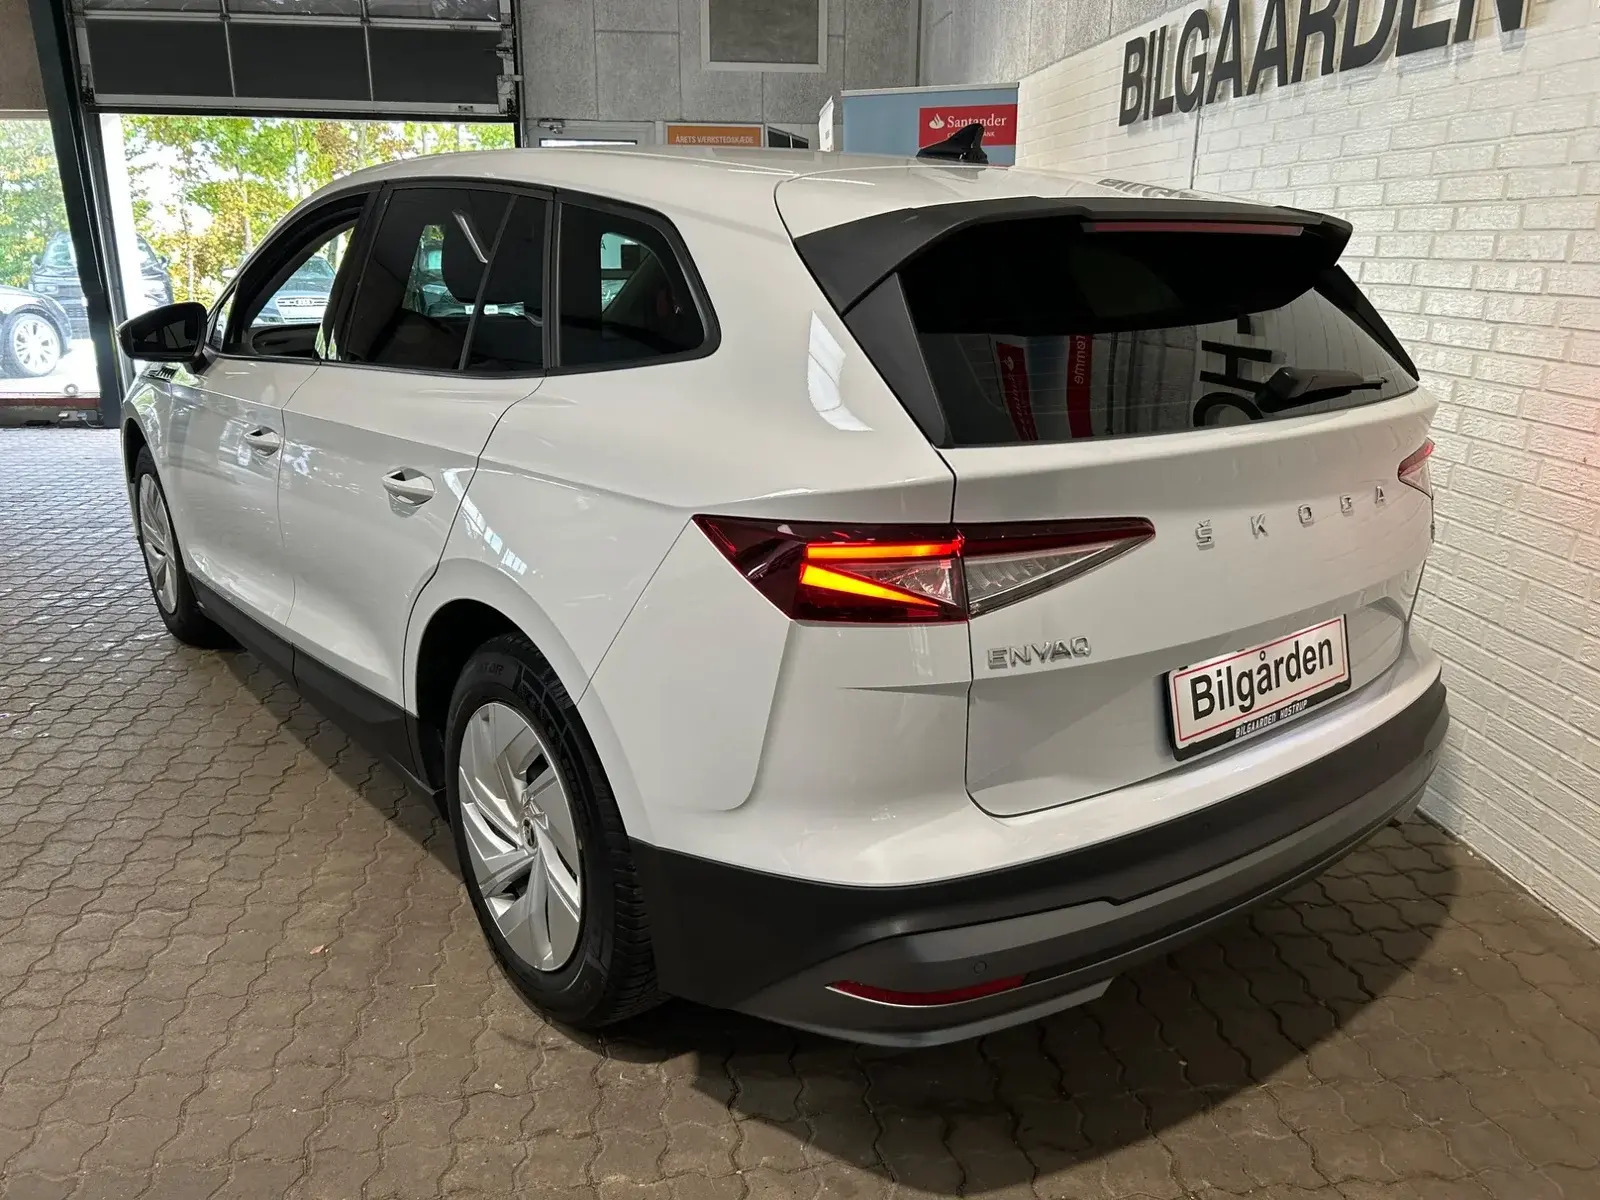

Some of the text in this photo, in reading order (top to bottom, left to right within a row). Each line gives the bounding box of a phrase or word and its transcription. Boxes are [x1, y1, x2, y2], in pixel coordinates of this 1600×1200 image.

[1118, 0, 1523, 127] BILGAARD
[947, 113, 1007, 128] Santander
[675, 134, 697, 143] ÅRETS
[987, 636, 1092, 669] ENYAQ
[1190, 638, 1334, 721] Bilgården
